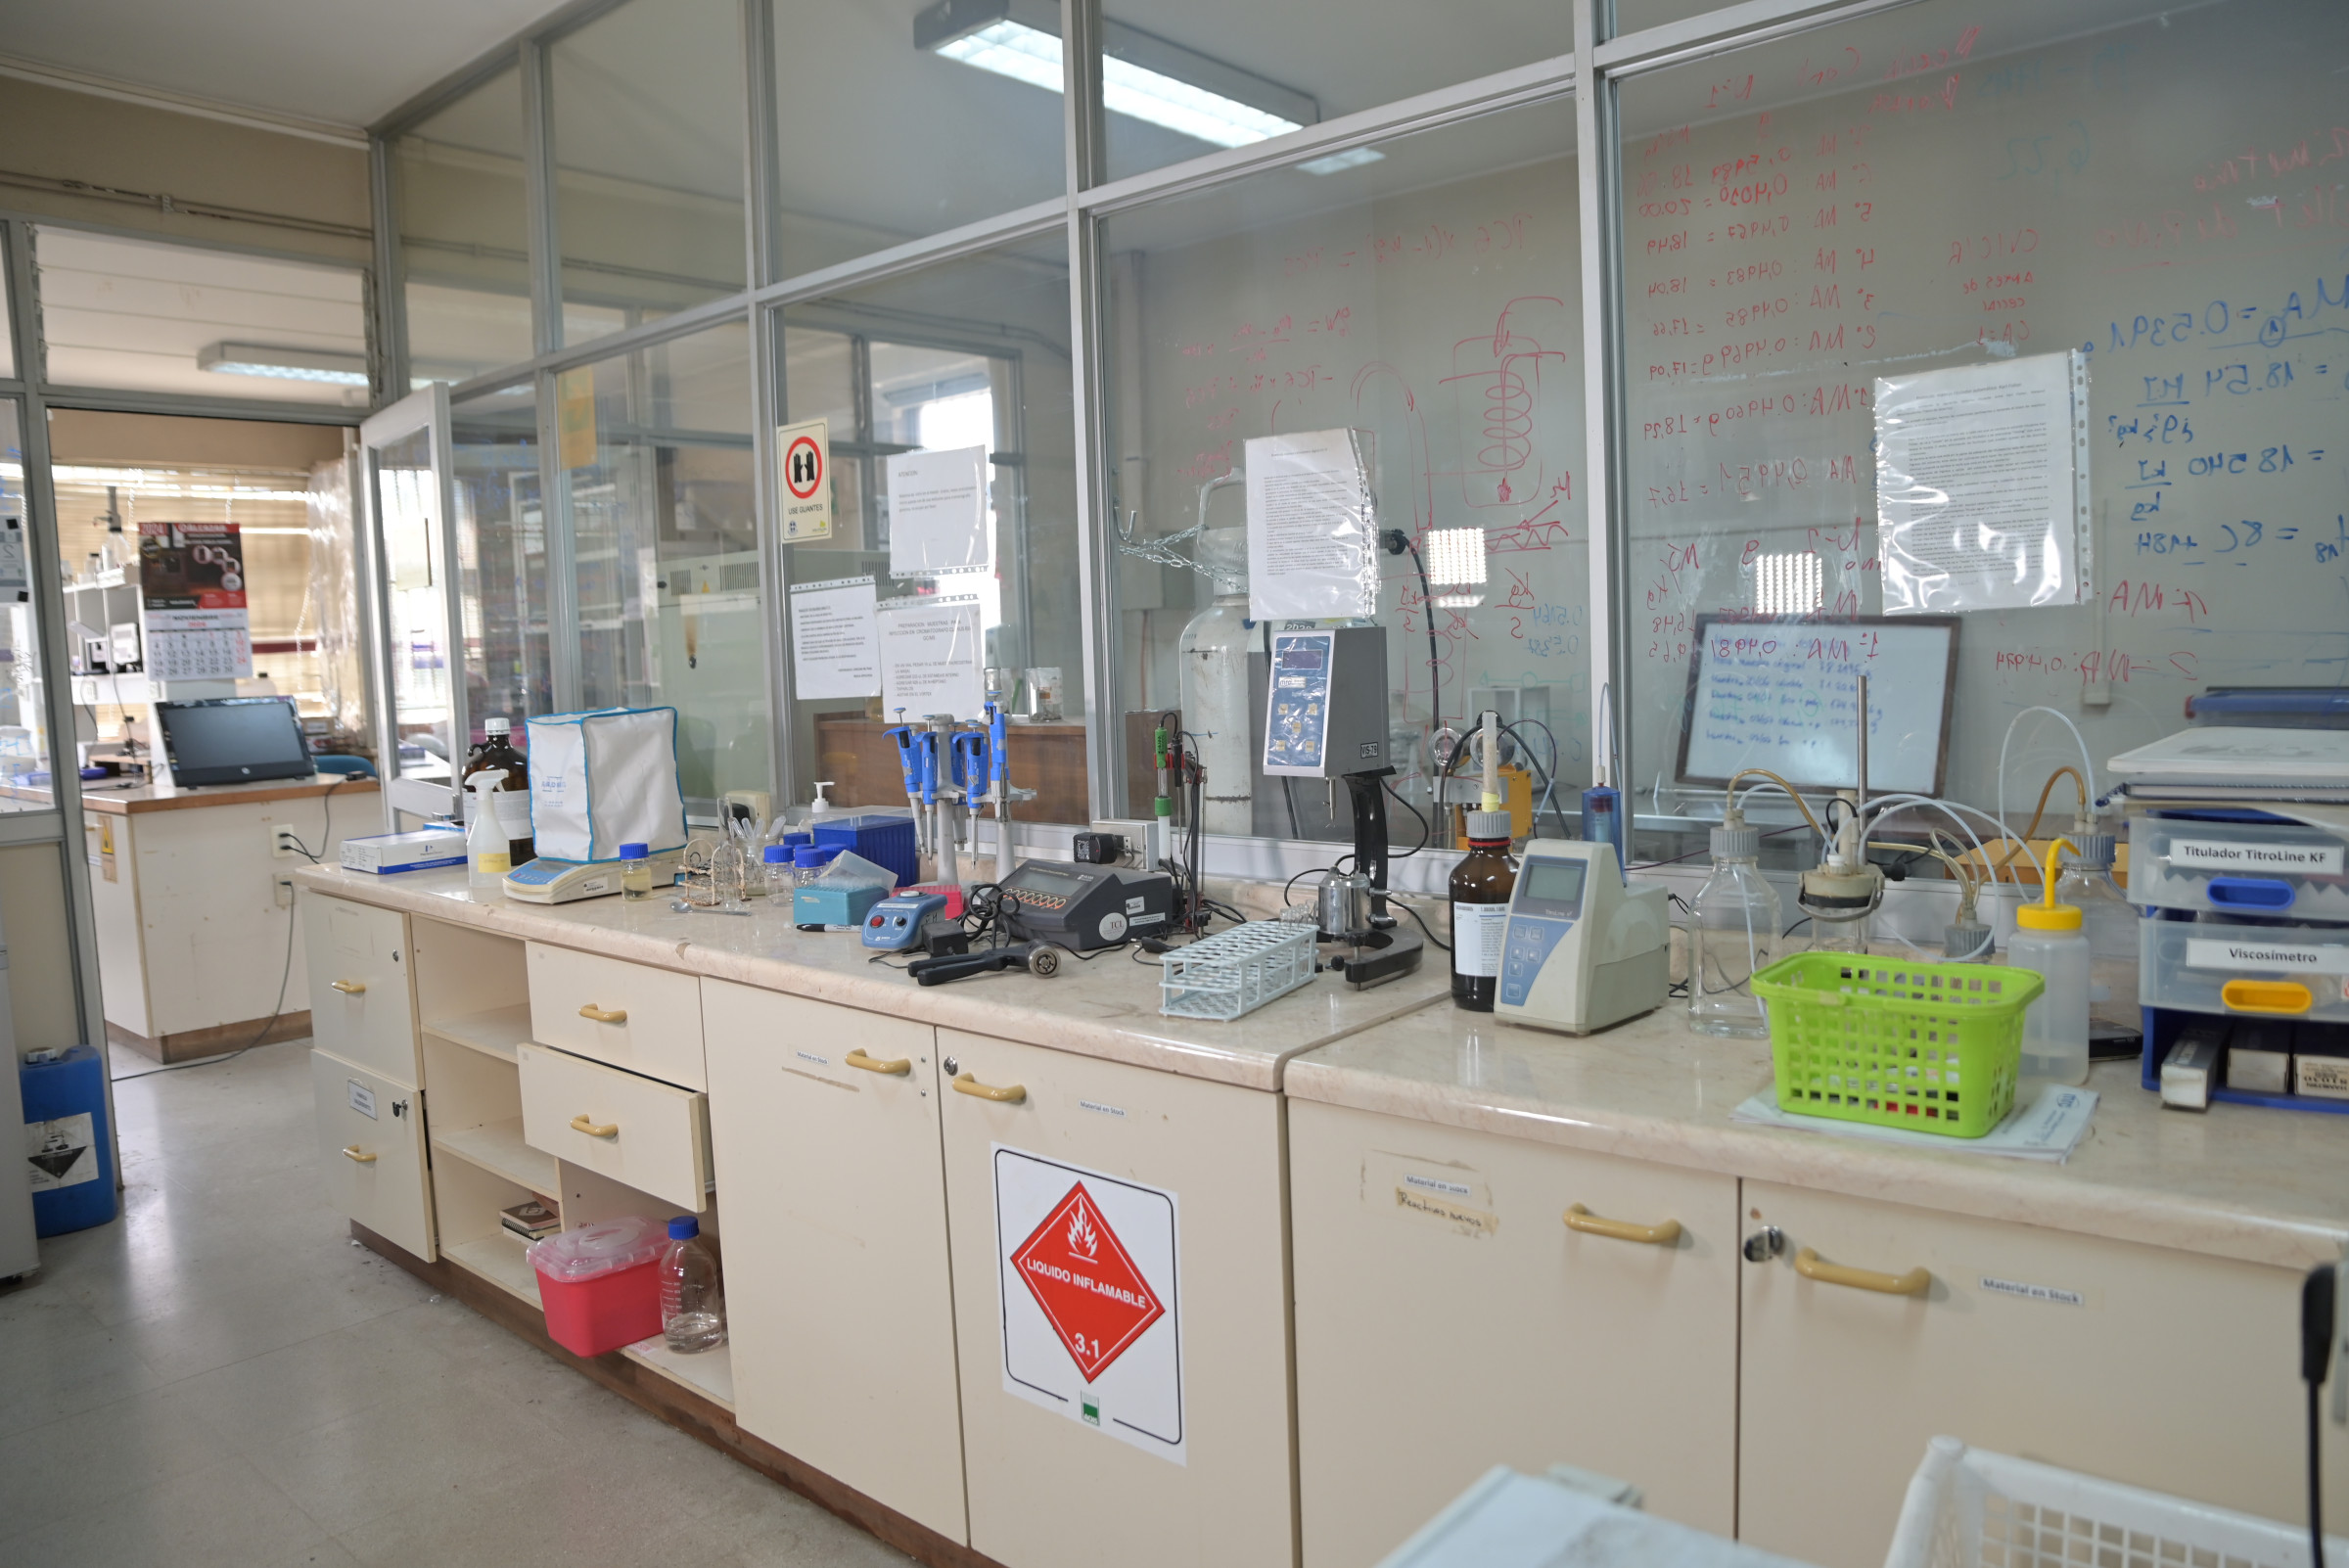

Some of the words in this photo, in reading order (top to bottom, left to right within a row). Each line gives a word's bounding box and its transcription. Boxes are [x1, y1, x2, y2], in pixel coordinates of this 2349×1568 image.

[800, 504, 823, 513] GUANTES
[2183, 846, 2241, 860] Titulador
[2244, 849, 2306, 864] TitroLine
[2309, 853, 2326, 864] KF
[1081, 1101, 1101, 1110] Material
[1406, 1176, 1436, 1188] Material
[1026, 1257, 1071, 1284] LIQUIDO
[1073, 1272, 1146, 1309] INFLAMABLE
[1983, 1278, 2029, 1294] Material
[2032, 1288, 2046, 1298] en
[2049, 1289, 2079, 1303] Stock
[1074, 1331, 1100, 1360] 3.1
